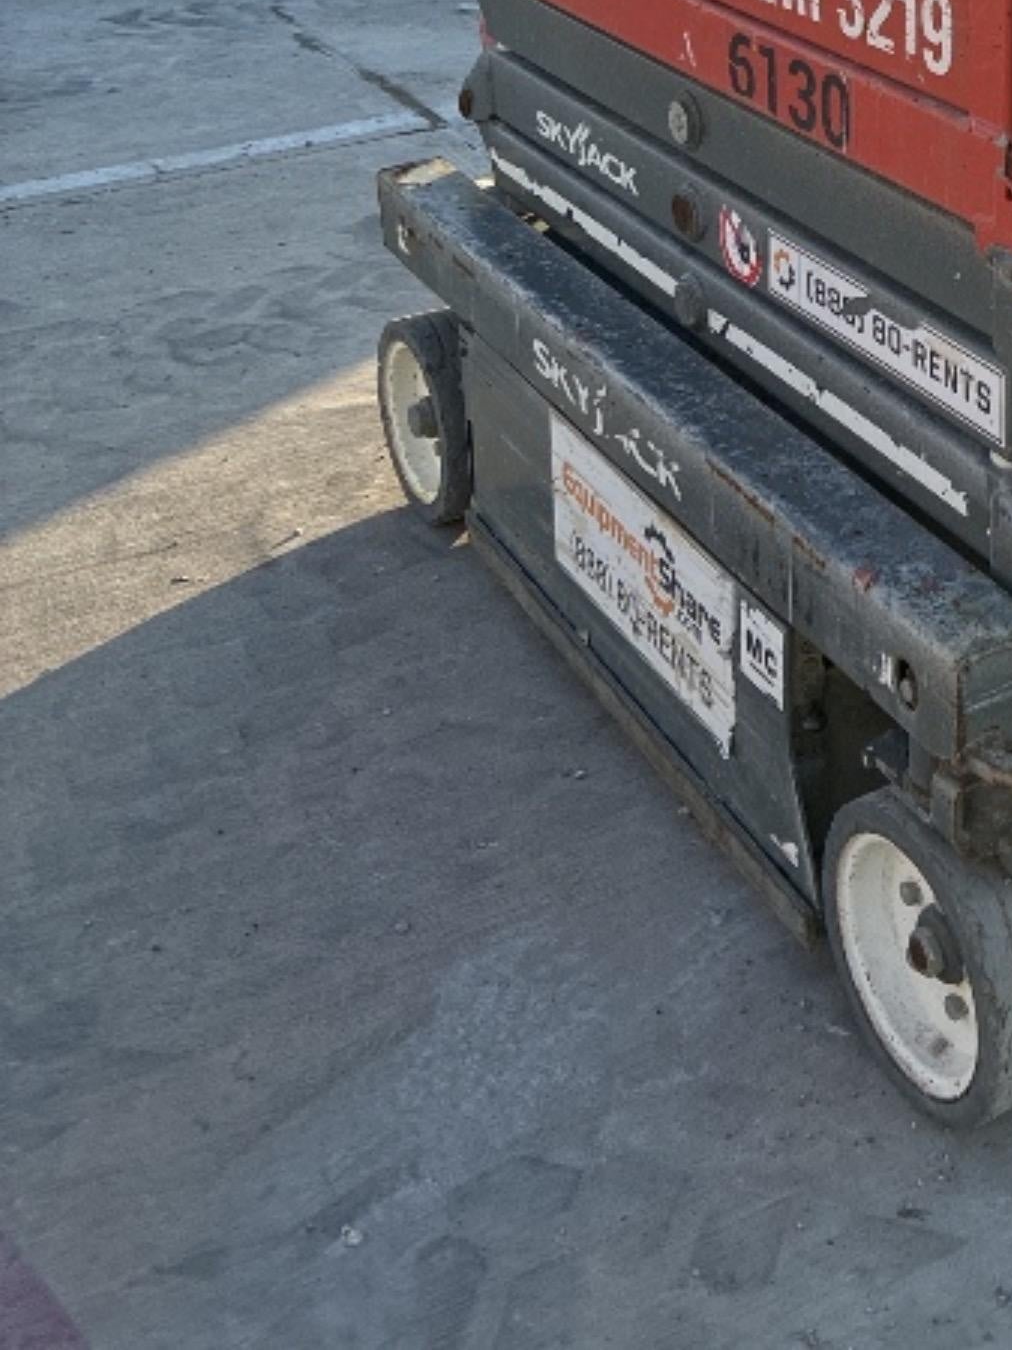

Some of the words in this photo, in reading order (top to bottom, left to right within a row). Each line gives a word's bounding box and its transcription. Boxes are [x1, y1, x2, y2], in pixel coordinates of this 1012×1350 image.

[728, 32, 849, 149] 6130
[536, 110, 639, 197] SKYJACK
[872, 314, 991, 416] 80-RENTS
[746, 629, 778, 680] MC
